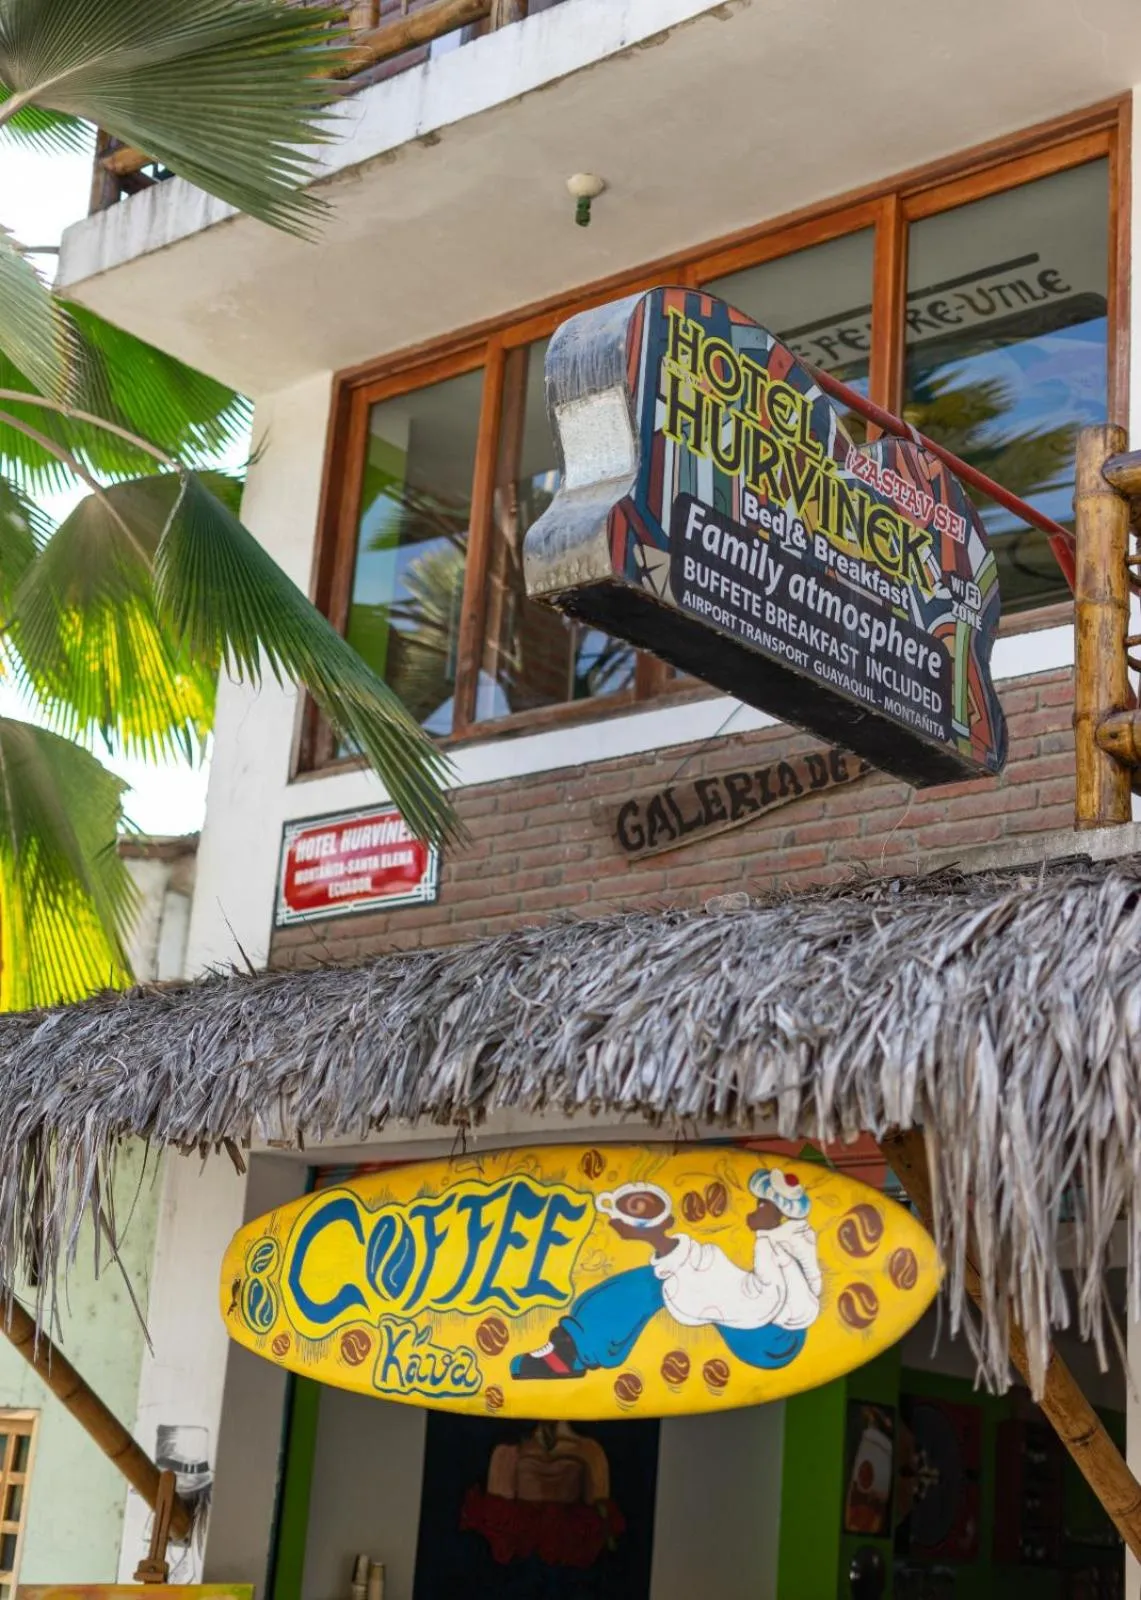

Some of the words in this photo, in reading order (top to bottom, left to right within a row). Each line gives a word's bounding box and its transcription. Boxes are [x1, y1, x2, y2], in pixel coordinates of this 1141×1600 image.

[669, 305, 823, 461] HOTEL
[685, 503, 784, 595] Family
[789, 573, 942, 678] atmosphere
[743, 493, 785, 537] Bed
[792, 521, 808, 550] &
[814, 535, 909, 609] Breakfast
[933, 503, 967, 544] SE!
[682, 590, 738, 630] AIRPORT
[738, 619, 809, 668] TRANSPORT
[812, 660, 876, 703] GUAYAQUIL
[883, 695, 945, 739] MONTAÑITA
[683, 556, 761, 618] BUFFETE
[765, 601, 860, 670] BREAKFAST
[866, 655, 942, 713] INCLUDED
[951, 600, 983, 632] ZONE
[617, 762, 803, 851] GALERIA
[804, 750, 849, 788] DE
[288, 1180, 588, 1324] COFFEE
